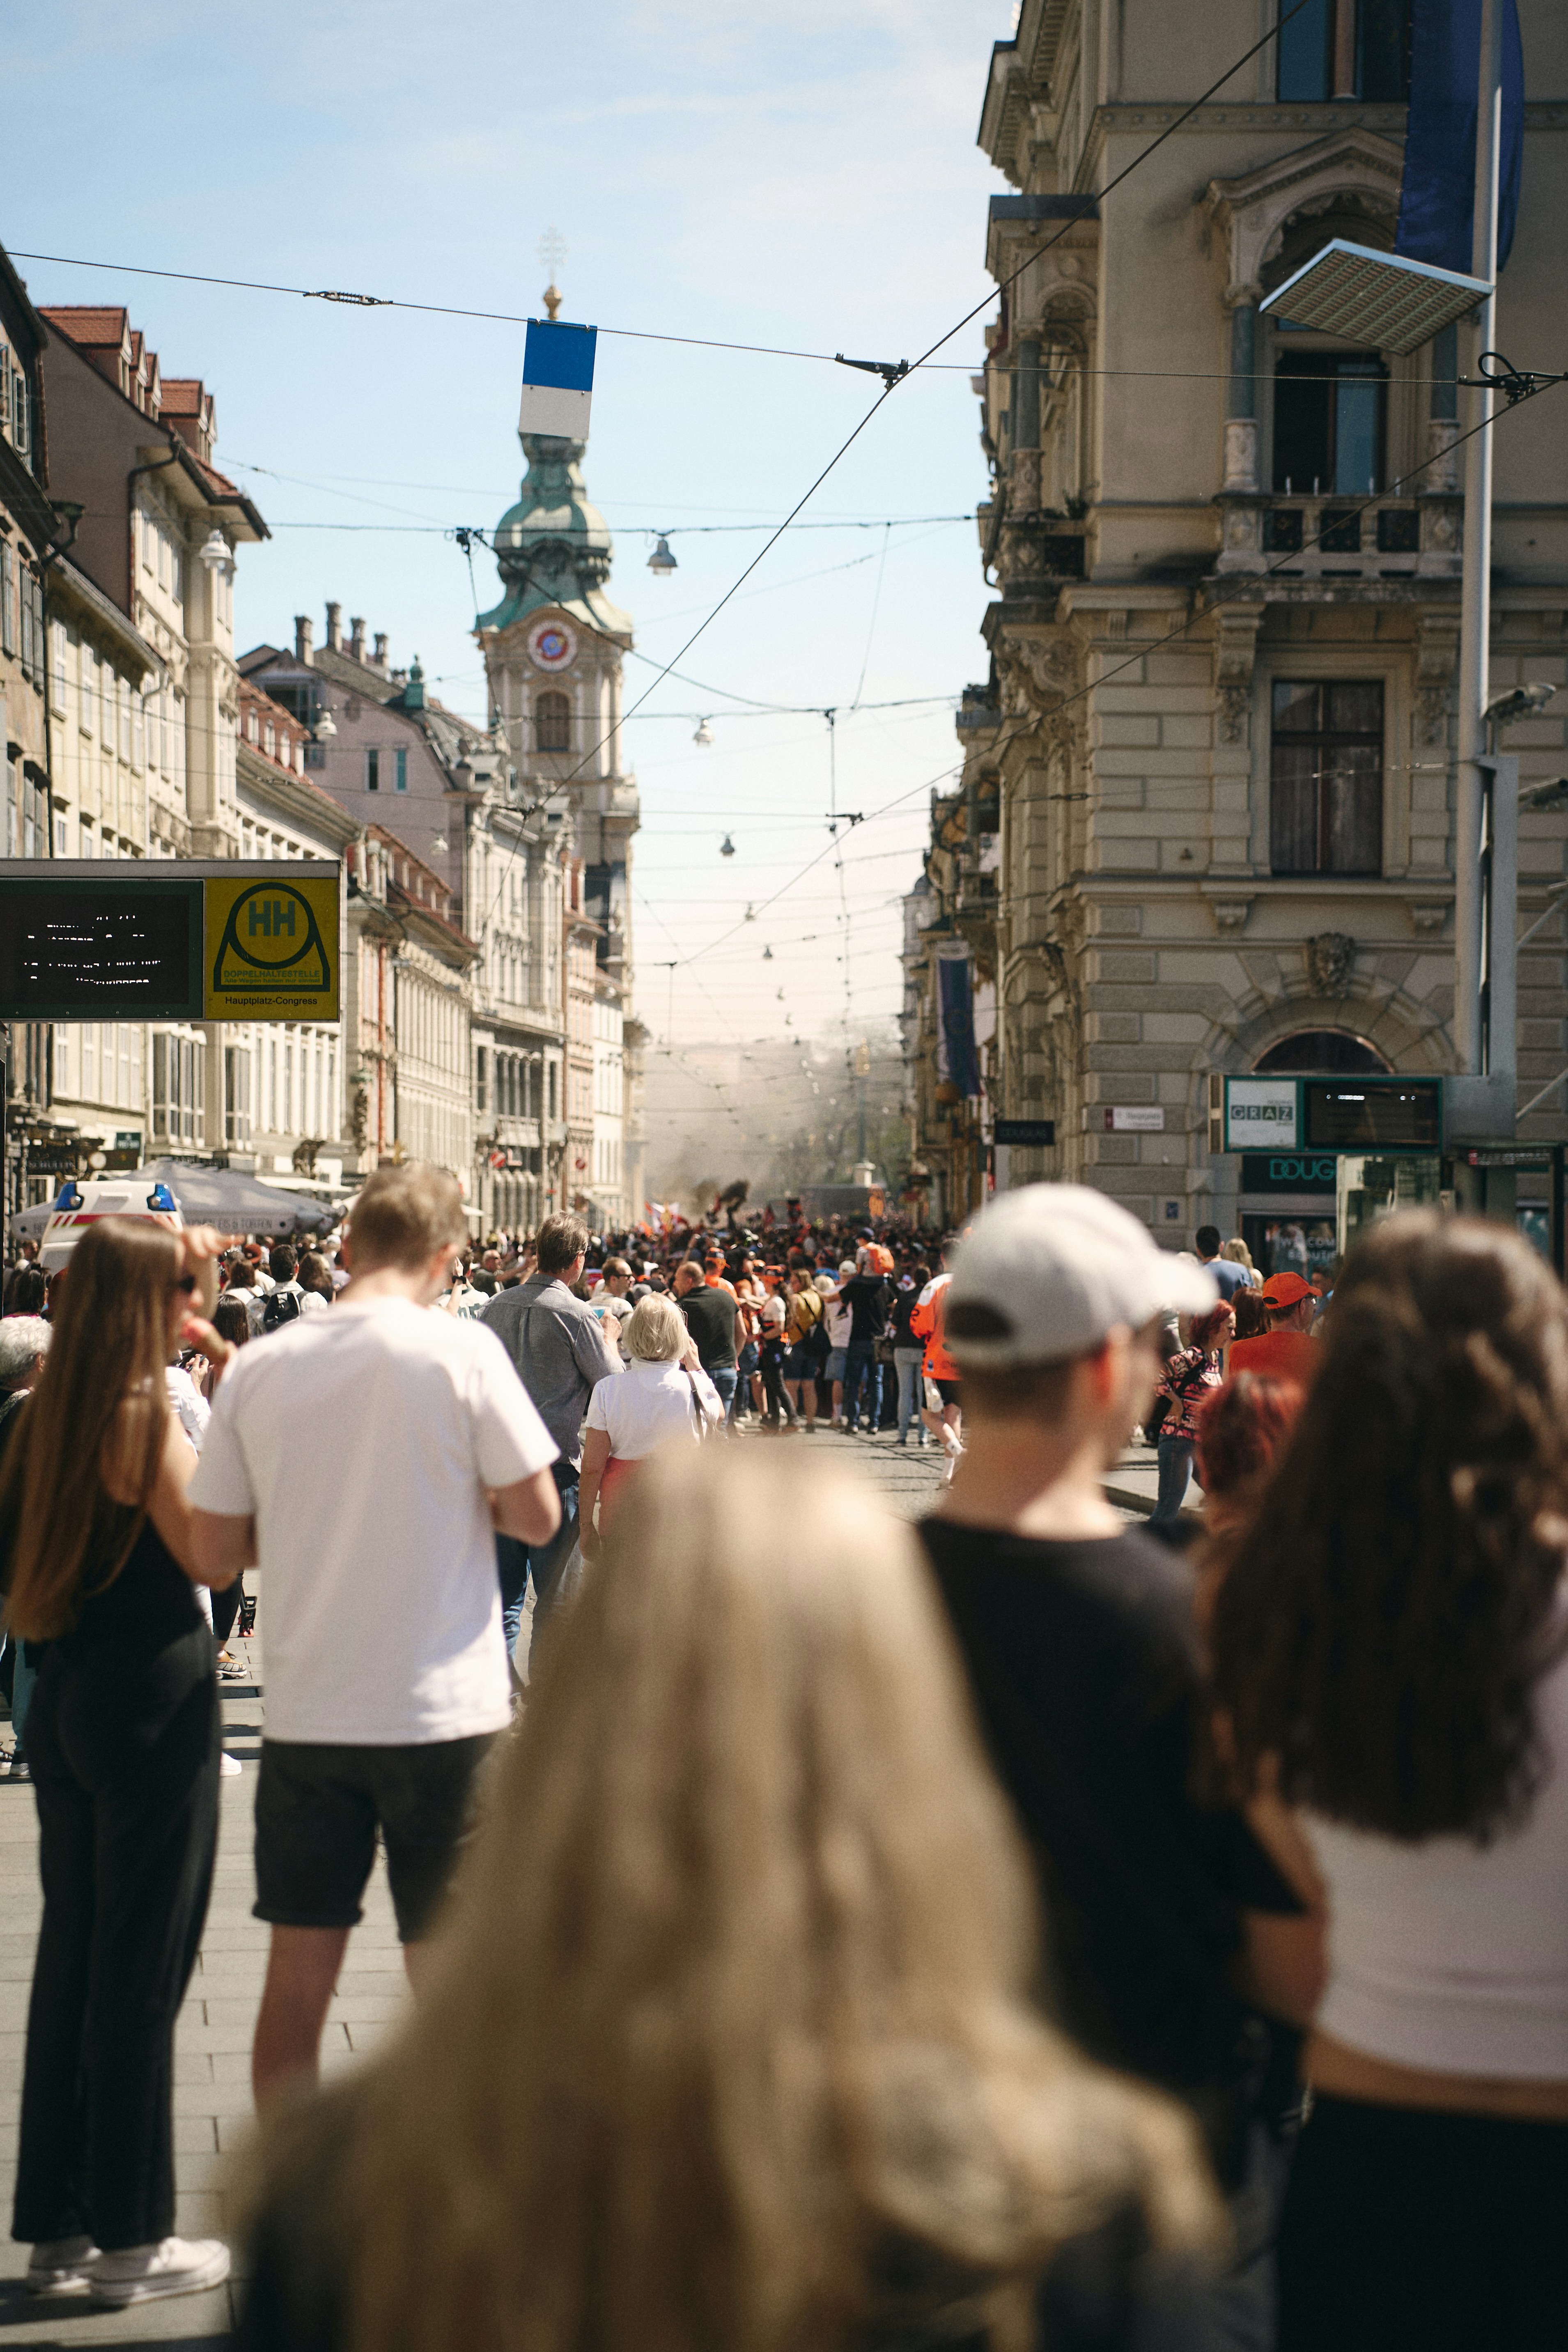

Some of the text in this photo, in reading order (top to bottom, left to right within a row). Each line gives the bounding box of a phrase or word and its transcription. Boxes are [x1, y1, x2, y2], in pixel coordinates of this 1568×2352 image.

[249, 900, 295, 936] HH
[225, 997, 317, 1006] Hauptplatz-Congress
[1232, 1106, 1291, 1120] GRAZ
[1270, 1159, 1336, 1181] DOUG
